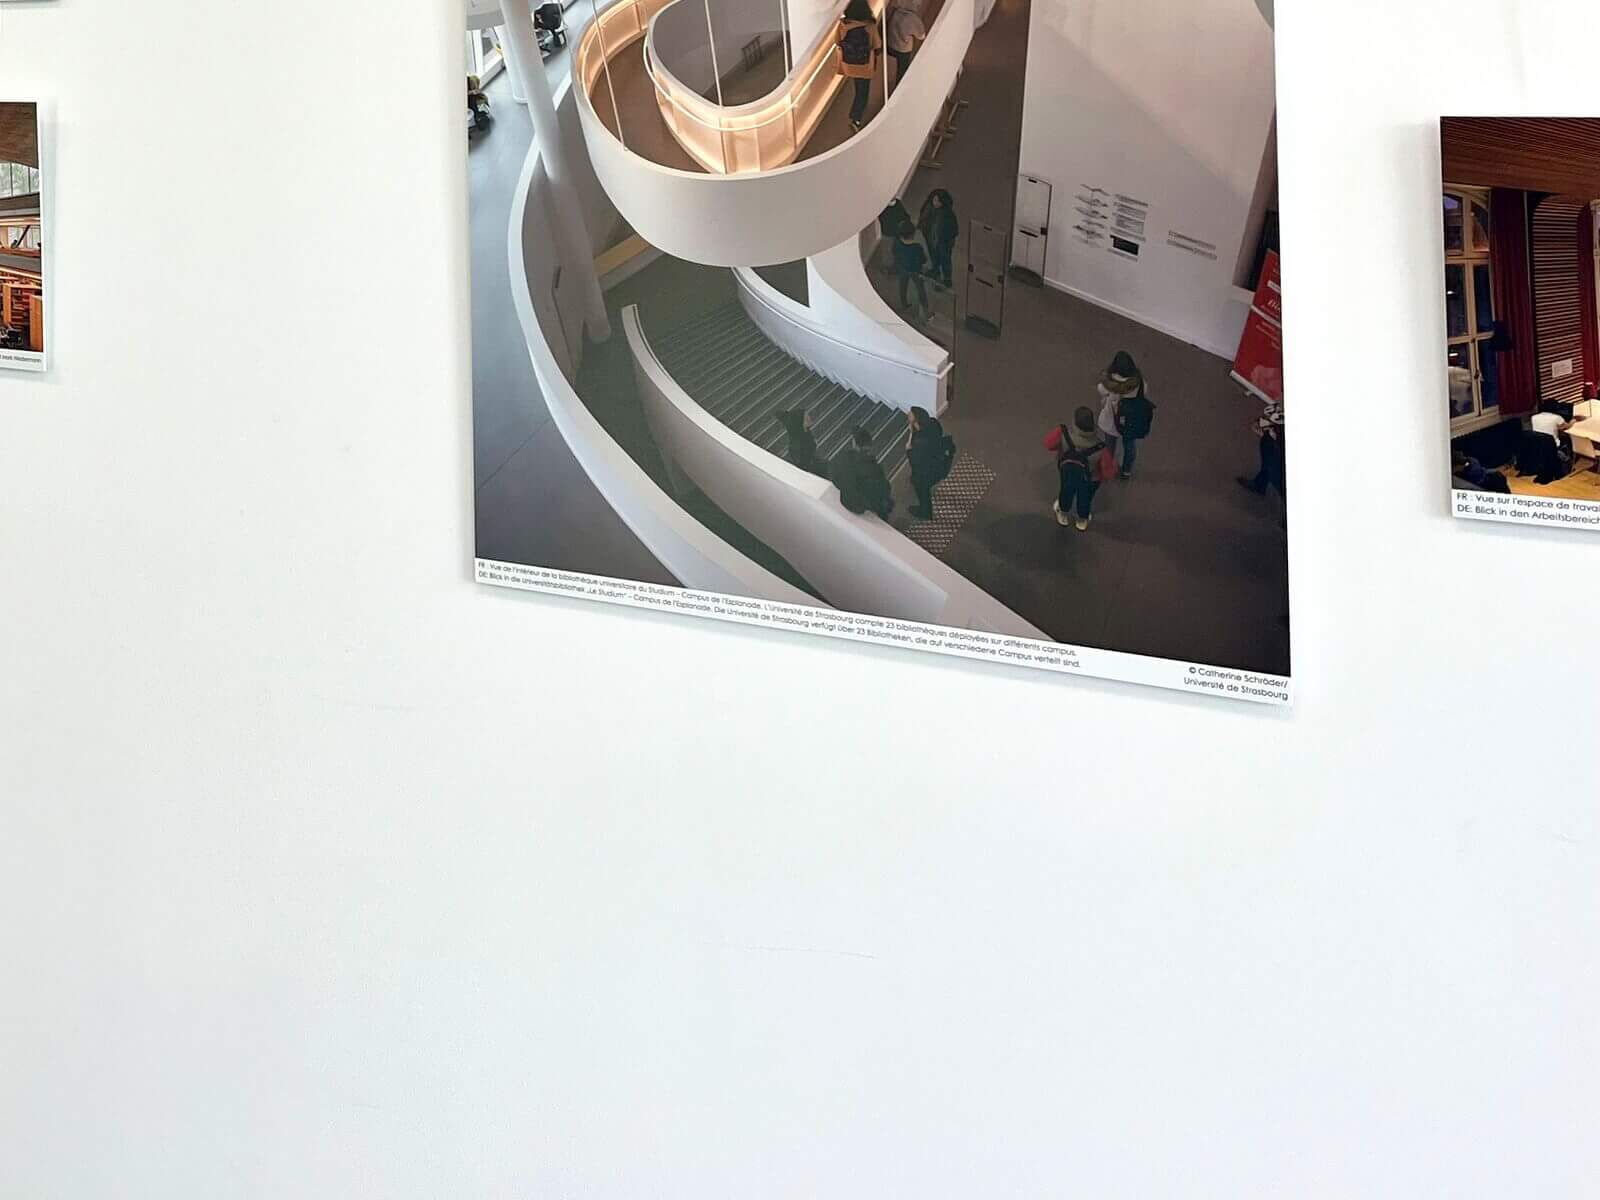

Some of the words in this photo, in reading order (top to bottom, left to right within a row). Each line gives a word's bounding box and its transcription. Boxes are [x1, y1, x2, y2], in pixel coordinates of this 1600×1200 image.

[1475, 494, 1494, 503] Vue
[1556, 501, 1569, 509] de
[1476, 506, 1496, 515] Blick
[1499, 507, 1507, 516] in
[1510, 508, 1529, 518] den
[490, 563, 502, 572] Vue
[503, 564, 512, 573] de
[541, 570, 551, 579] de
[599, 580, 637, 591] universitaire
[649, 586, 675, 597] Studium
[681, 591, 710, 602] Campus
[711, 595, 720, 604] de
[804, 609, 814, 618] de
[815, 610, 854, 625] Strasbourg
[855, 617, 884, 628] compte
[886, 621, 895, 630] 23
[896, 622, 947, 637] bibliothèques
[949, 630, 989, 643] déployées
[991, 637, 1001, 645] sur
[1003, 638, 1041, 651] différents
[489, 572, 503, 581] Blick
[511, 575, 521, 584] die
[633, 593, 661, 605] Campus
[662, 598, 672, 607] de
[714, 606, 726, 615] Die
[727, 608, 759, 620] Université
[761, 612, 771, 621] de
[772, 614, 809, 629] Strasbourg
[811, 621, 837, 631] verfügt
[837, 625, 855, 634] über
[856, 627, 866, 636] 23
[915, 636, 928, 645] die
[929, 638, 942, 647] auf
[944, 641, 996, 655] verschiedene
[998, 648, 1033, 661] Campus
[1034, 655, 1061, 665] verteilt
[1198, 668, 1242, 680] Catherine
[1184, 677, 1224, 690] Université
[1227, 684, 1239, 692] de
[1241, 686, 1288, 701] Strasbourg
